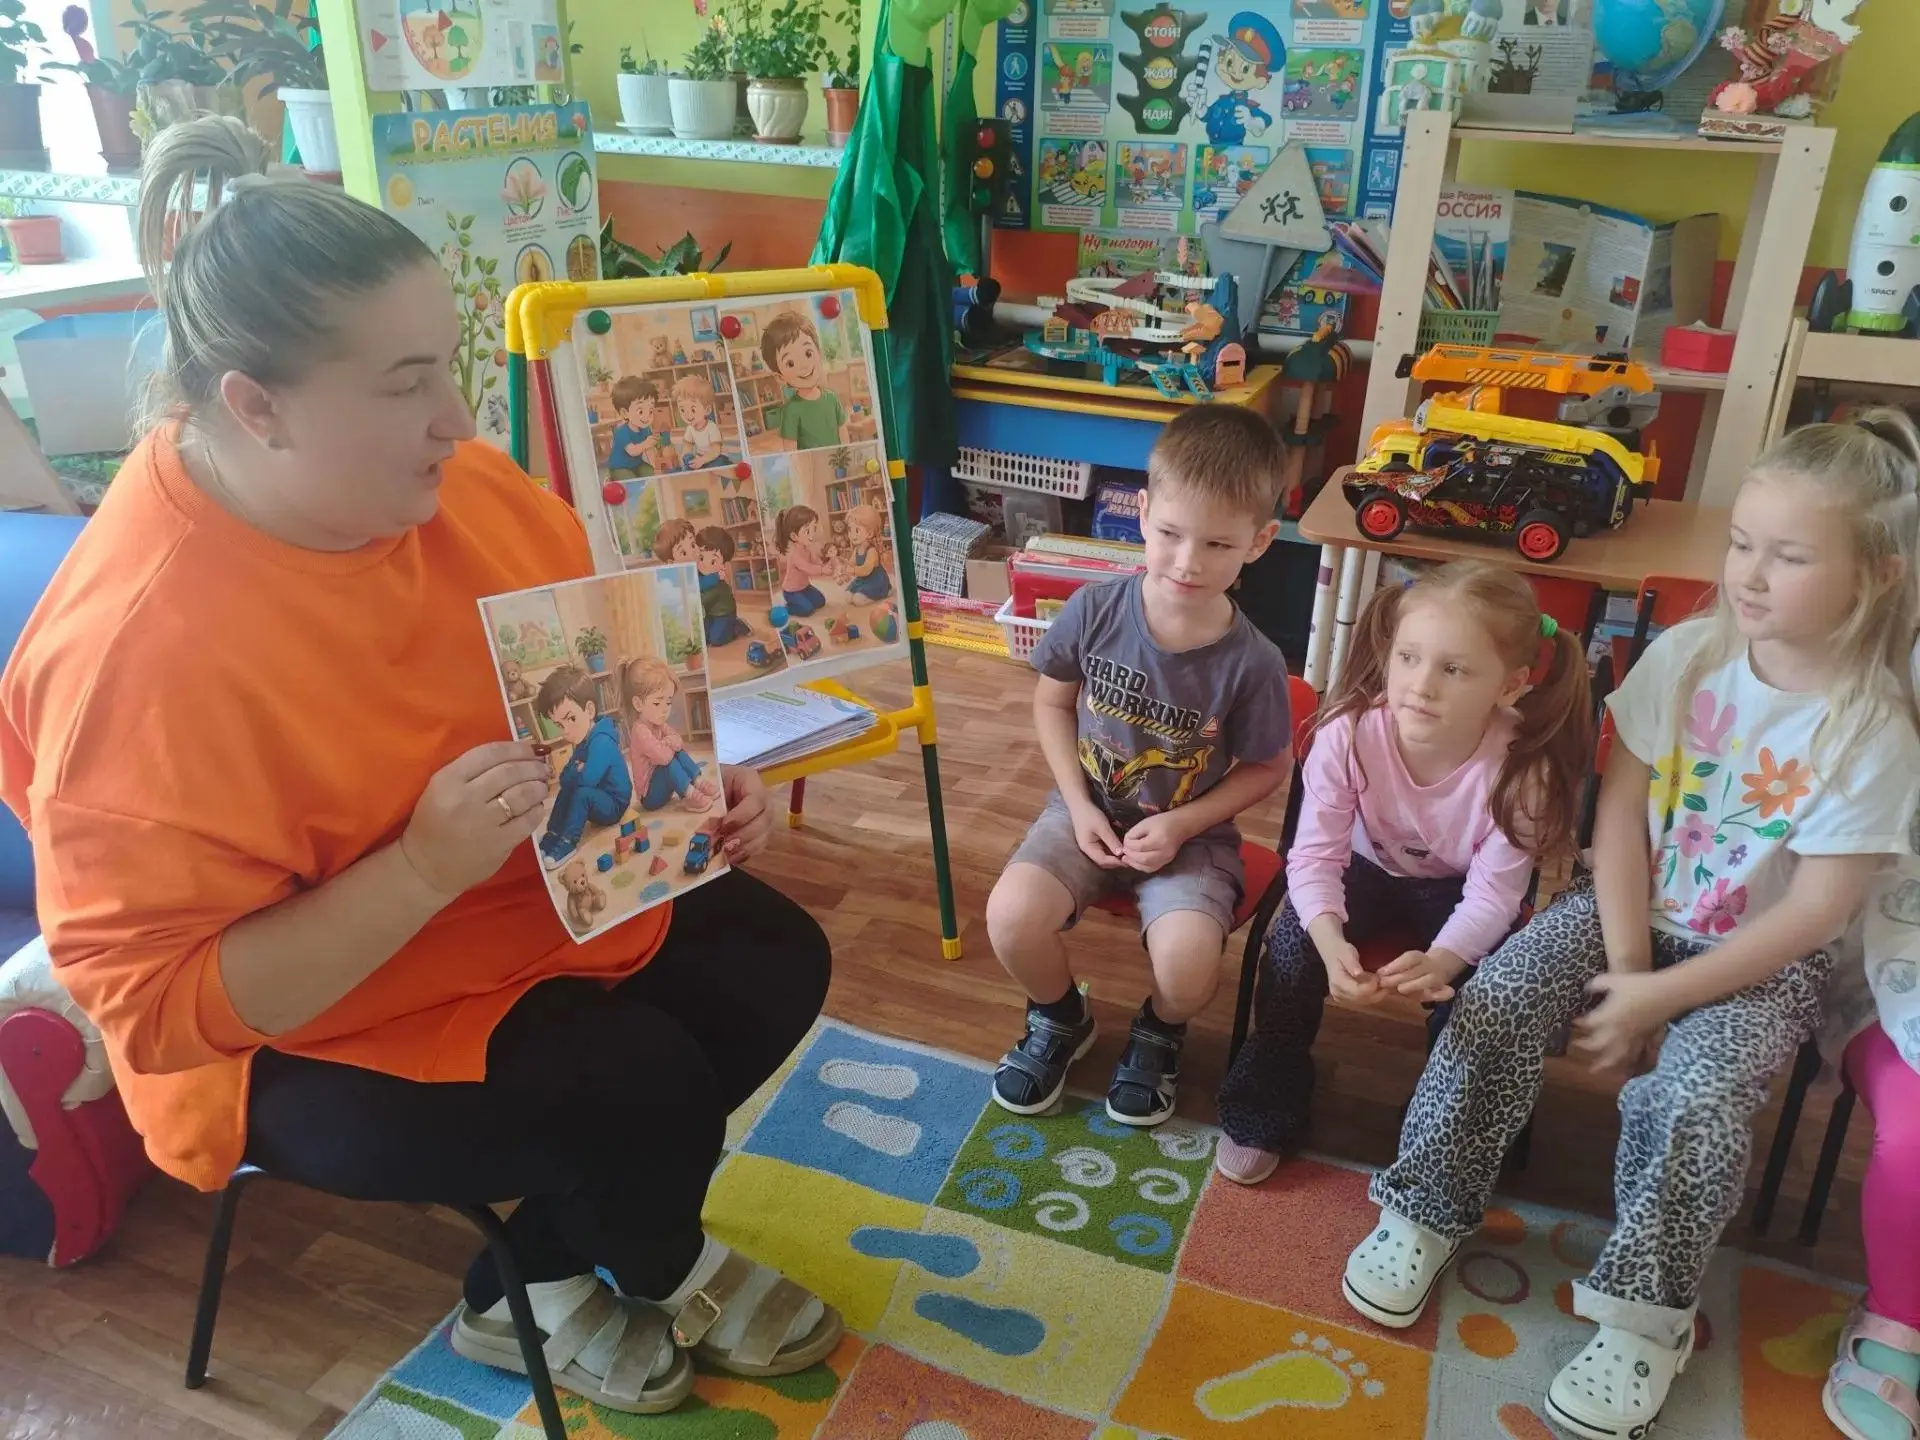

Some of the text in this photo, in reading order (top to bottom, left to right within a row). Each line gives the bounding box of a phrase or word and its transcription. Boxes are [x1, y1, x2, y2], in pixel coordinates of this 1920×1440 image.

[1144, 24, 1180, 38] СТОЙ!
[1144, 67, 1177, 80] ЖДИ!
[1142, 108, 1173, 121] ИДИ!
[412, 112, 557, 153] РАСТЕНИЯ
[1437, 201, 1502, 219] ОССИЯ
[1871, 287, 1897, 296] SPACE
[1086, 654, 1149, 694] HARD
[1091, 677, 1202, 730] WORKING
